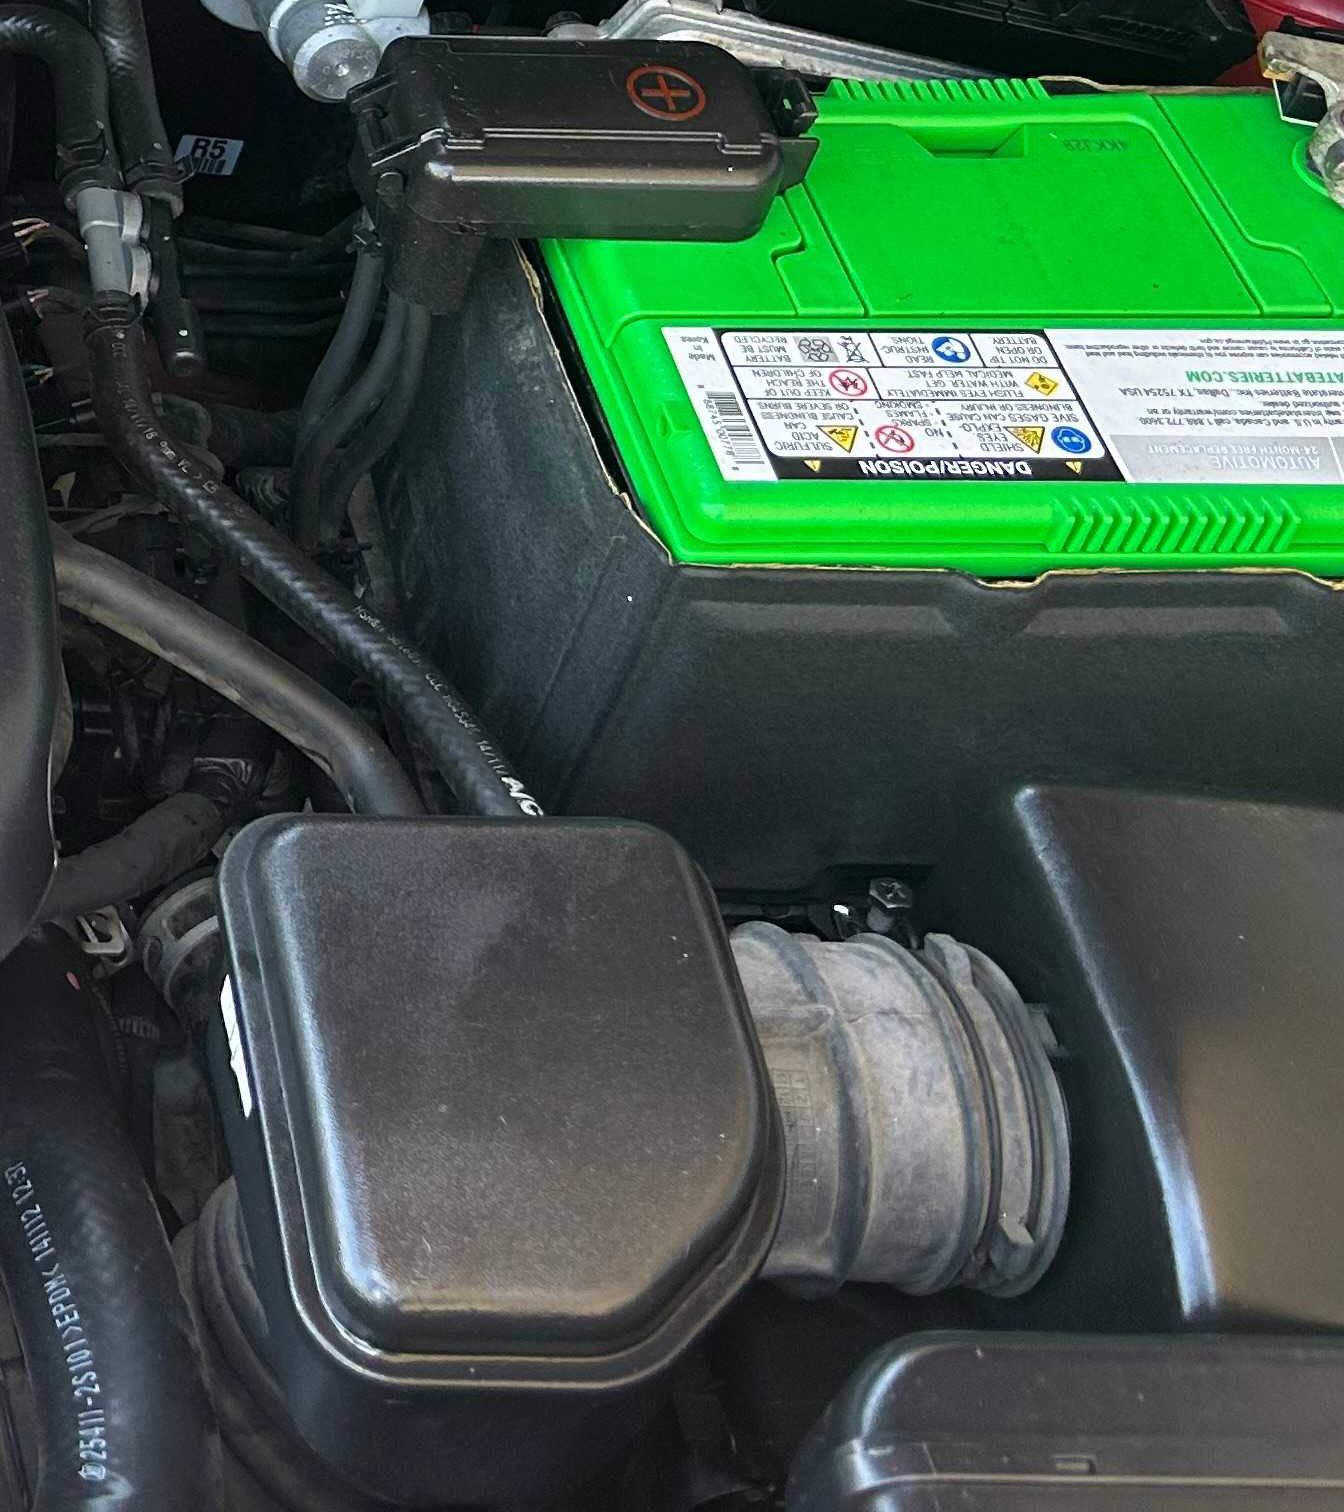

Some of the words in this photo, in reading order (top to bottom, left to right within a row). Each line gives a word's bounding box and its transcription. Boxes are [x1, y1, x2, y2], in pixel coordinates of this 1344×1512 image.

[191, 138, 229, 160] R5
[739, 345, 753, 353] BE
[755, 345, 786, 353] MUST
[995, 346, 1024, 354] OPEN
[1024, 346, 1043, 354] OR
[688, 353, 716, 362] Made
[744, 354, 792, 363] BATTERY
[905, 356, 935, 364] READ
[990, 356, 1008, 364] TIP
[1008, 356, 1028, 364] NOT
[1029, 356, 1048, 364] DO
[750, 369, 806, 378] CHILDREN
[807, 369, 822, 378] OF
[935, 370, 964, 379] HELP
[965, 369, 1014, 379] MEDICAL
[1185, 370, 1344, 384] ATEBATTERIES.COM
[766, 378, 803, 387] REACH
[803, 379, 826, 387] THE
[925, 379, 946, 388] GET
[989, 379, 1019, 388] WITH
[763, 388, 778, 397] OF
[779, 388, 801, 397] OUT
[803, 388, 832, 397] KEEP
[887, 389, 957, 398] IMMEDIATELY
[958, 389, 986, 398] EYES
[988, 389, 1024, 398] FLUSH
[1118, 388, 1142, 397] USA
[1143, 388, 1176, 397] 75254
[1253, 389, 1301, 398] Batteries
[758, 402, 791, 410] BURNS
[793, 402, 833, 411] SEVERE
[834, 402, 850, 411] OR
[874, 400, 923, 409] SMOKING
[997, 403, 1014, 412] OR
[1015, 403, 1073, 412] BLINDNESS
[760, 412, 822, 420] BLINDNESS
[823, 412, 854, 420] CAUSE
[885, 409, 928, 418] FLAMES
[946, 413, 981, 422] CAUSE
[983, 413, 1006, 422] CAN
[1007, 413, 1049, 423] GASES
[1052, 413, 1079, 423] SIVE
[892, 418, 932, 427] SPARKS
[791, 432, 819, 441] ACID
[924, 427, 944, 437] NO
[977, 432, 1009, 442] EYES
[773, 441, 833, 451] SULFURIC
[980, 442, 1025, 453] SHIELD
[857, 459, 1033, 476] DANGER/POISON
[1208, 455, 1320, 471] AUTOMOTIVE
[500, 775, 545, 817] A/C
